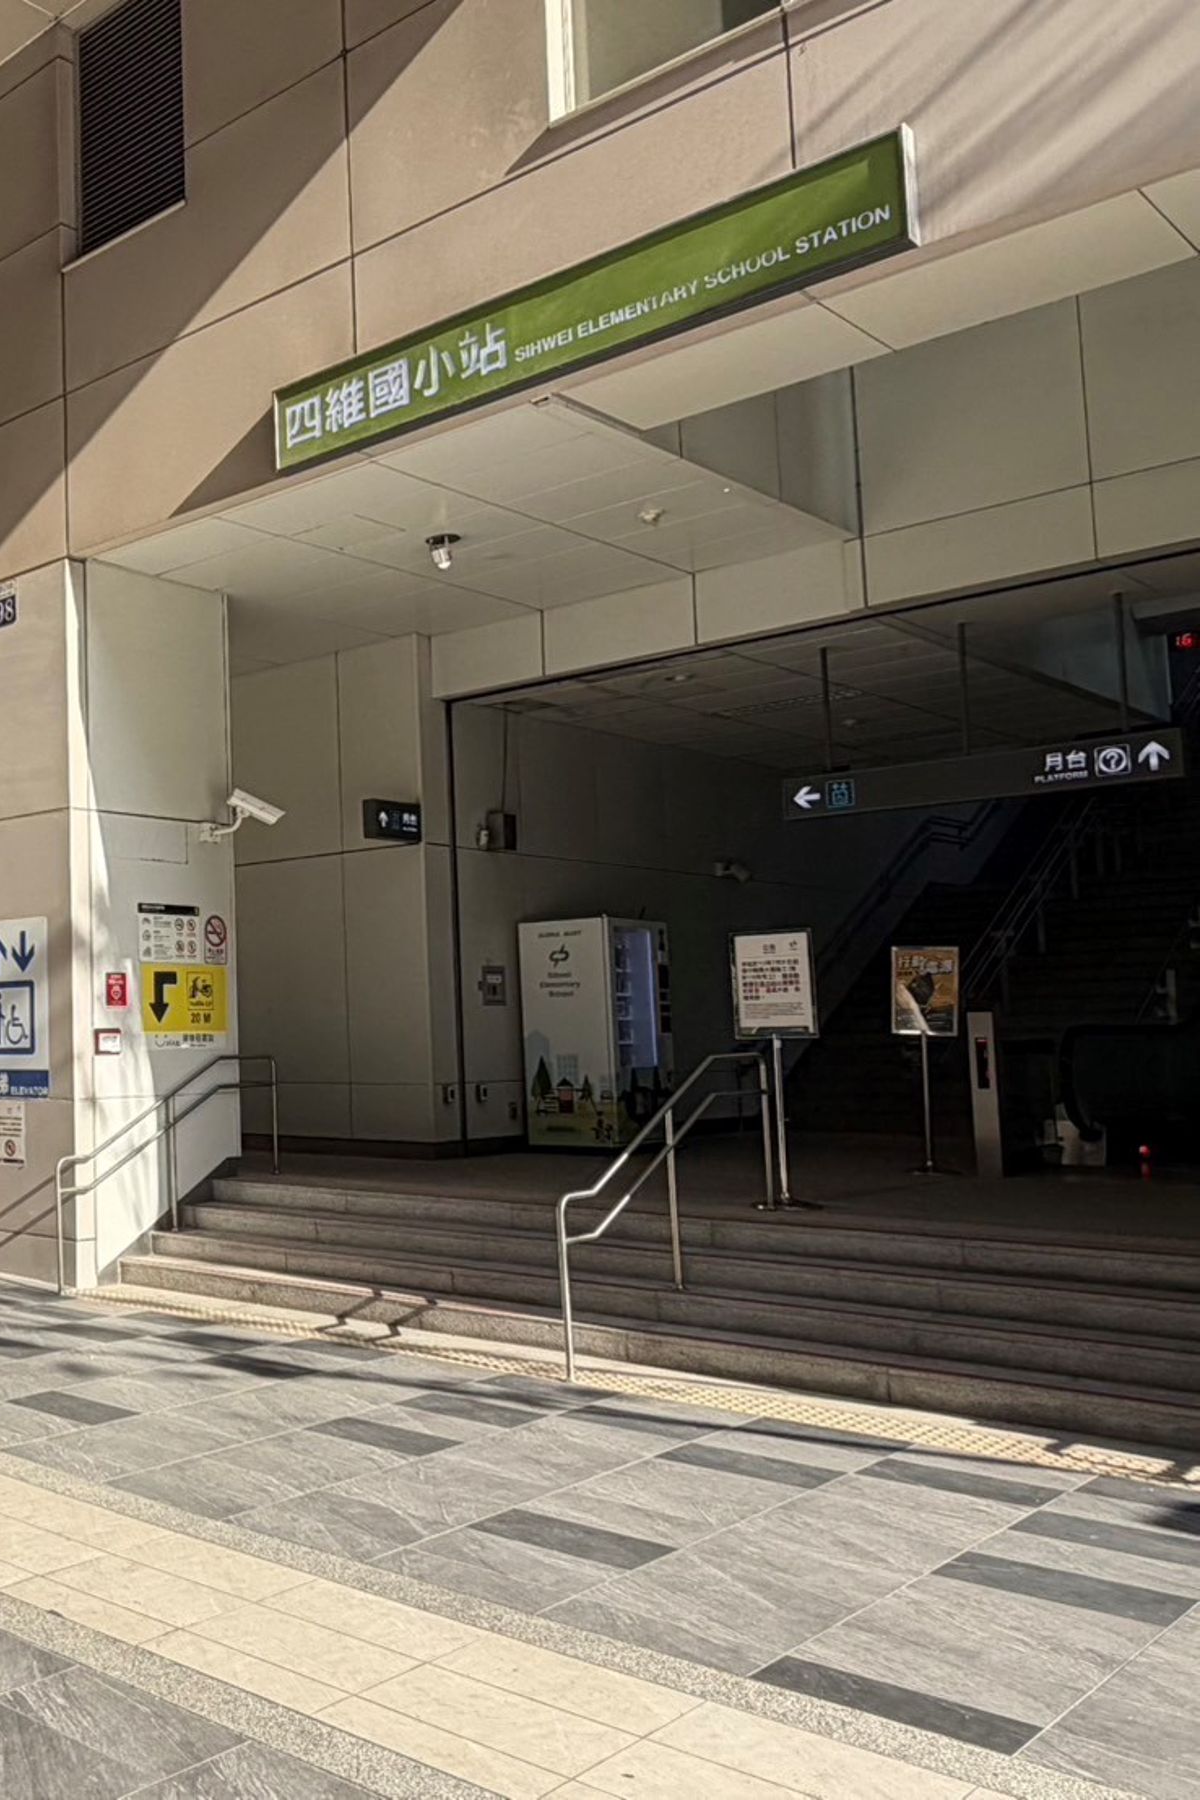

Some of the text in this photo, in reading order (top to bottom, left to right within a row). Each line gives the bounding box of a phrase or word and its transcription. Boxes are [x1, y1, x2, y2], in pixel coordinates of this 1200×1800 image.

[514, 204, 892, 364] SIHWEI ELEMENTARY SCHOOL STATION
[286, 322, 507, 449] 四維國小站
[1034, 769, 1089, 784] PLATFORM
[1044, 749, 1087, 772] 月台
